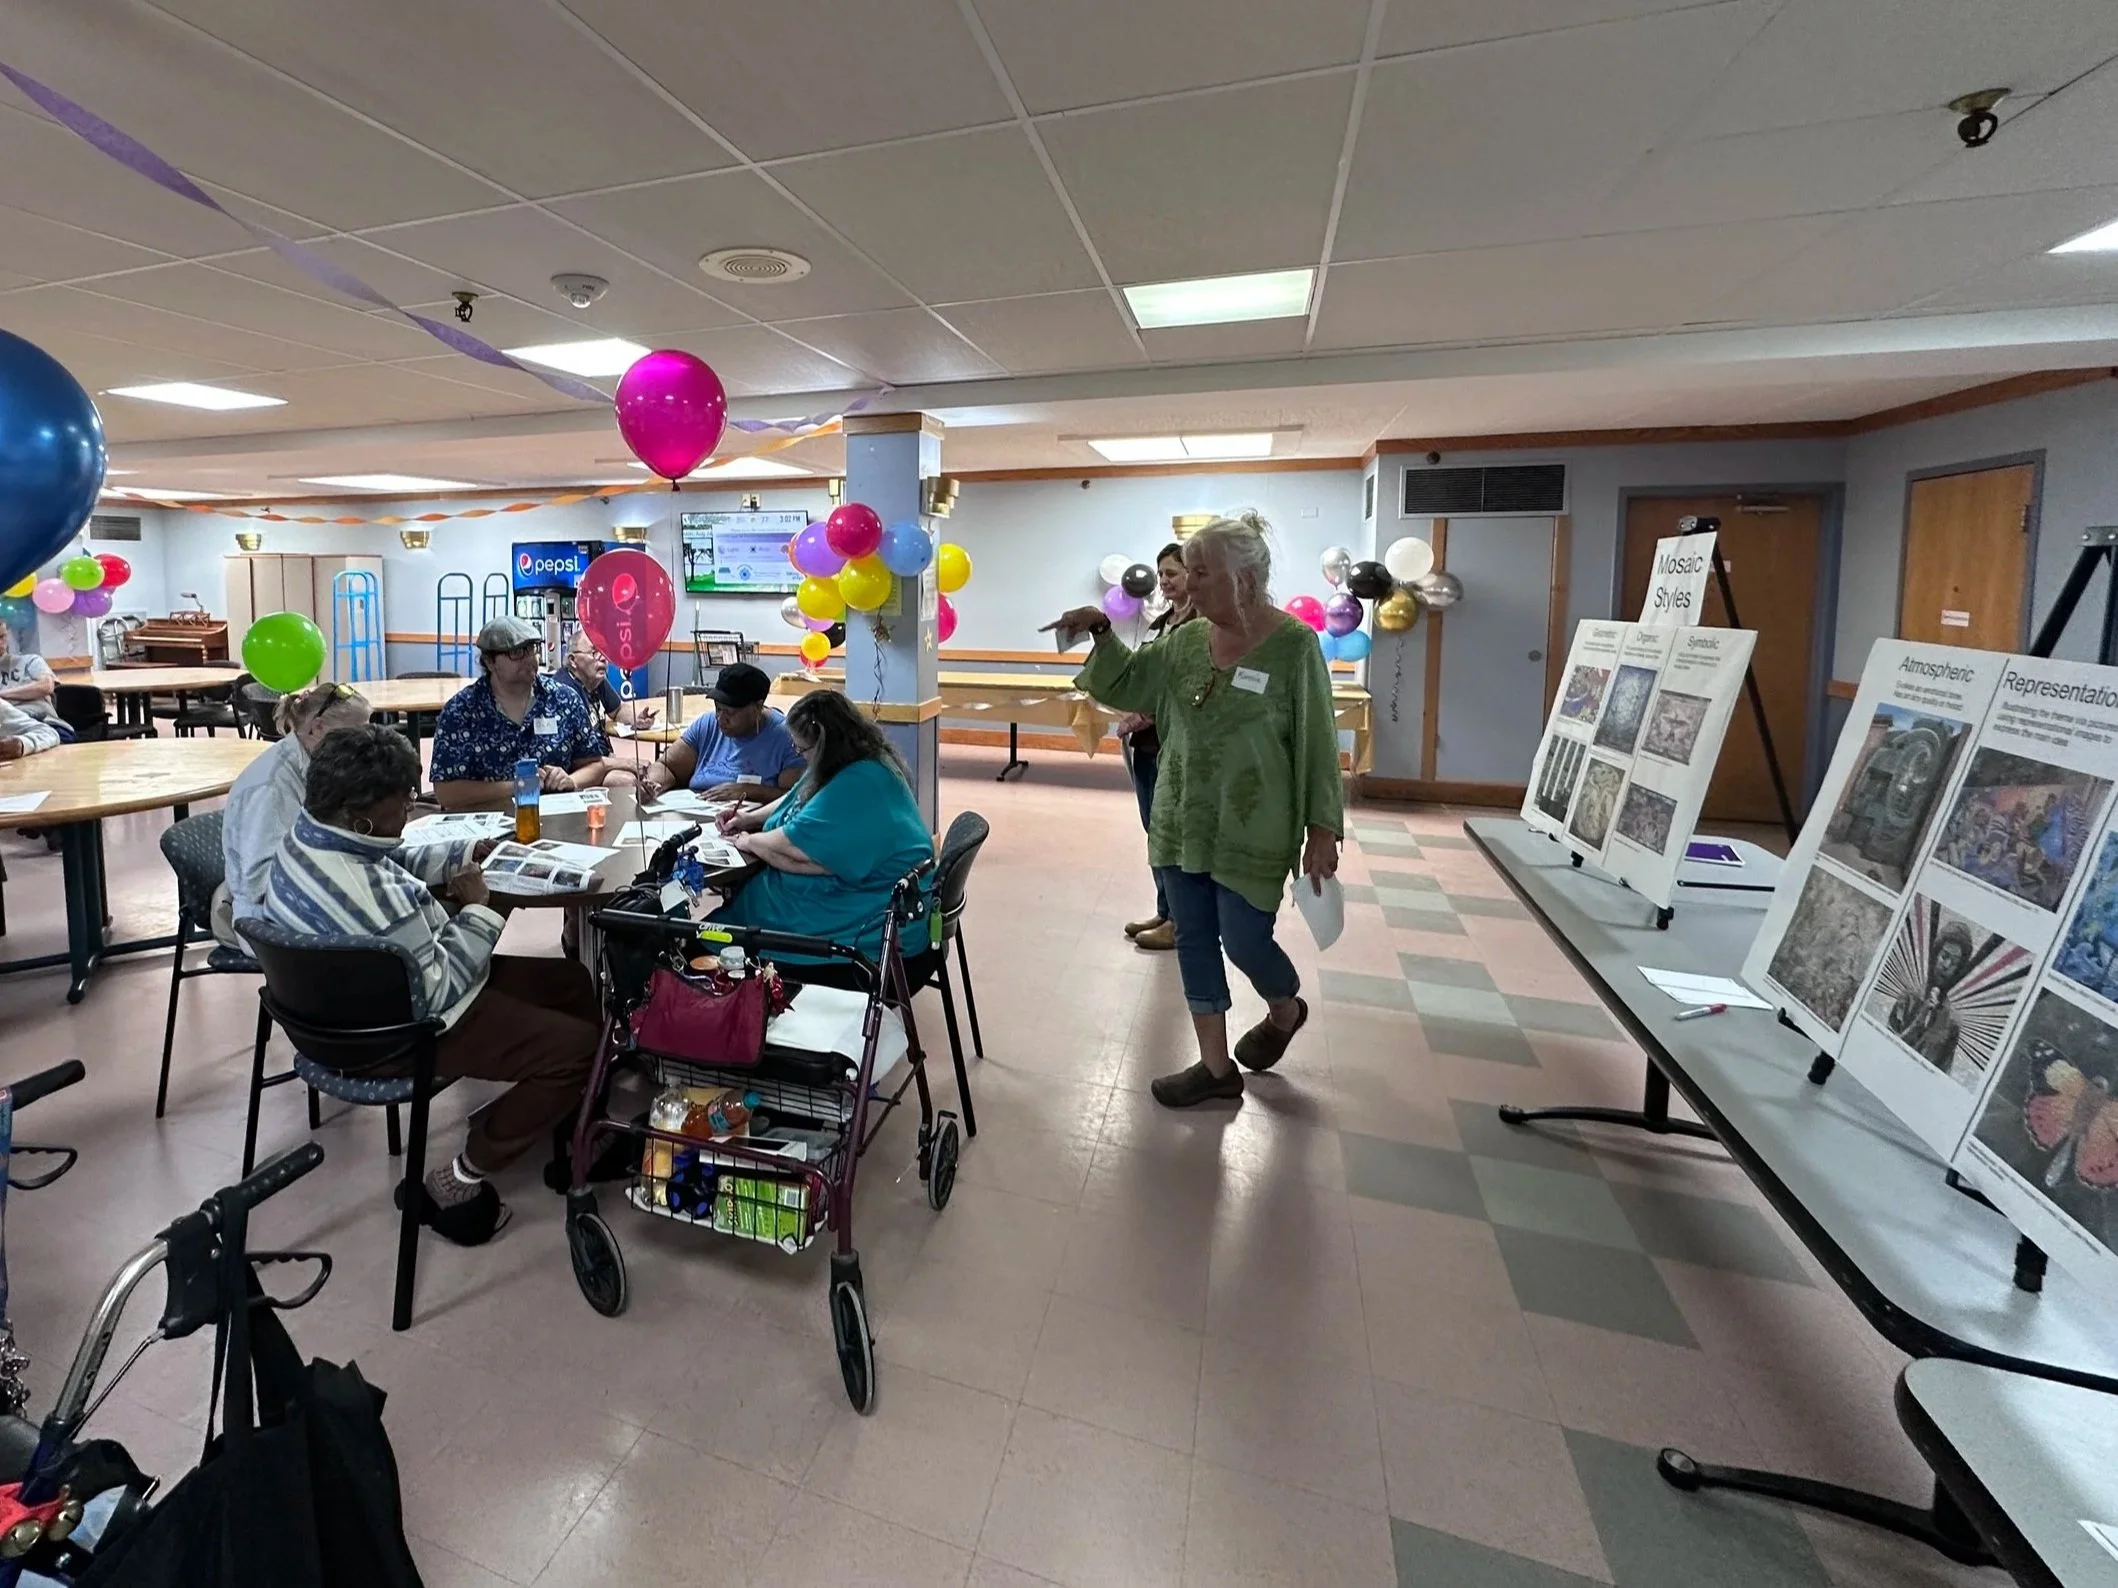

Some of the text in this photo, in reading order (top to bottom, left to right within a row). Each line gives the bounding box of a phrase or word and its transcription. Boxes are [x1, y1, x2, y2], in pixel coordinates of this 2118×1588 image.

[535, 556, 578, 576] pepsi
[1657, 551, 1703, 575] Mosaic
[1654, 586, 1691, 613] Styles
[1687, 635, 1721, 650] Symbolic
[1899, 656, 1975, 683] Atmospheric
[2003, 671, 2118, 708] Representatio
